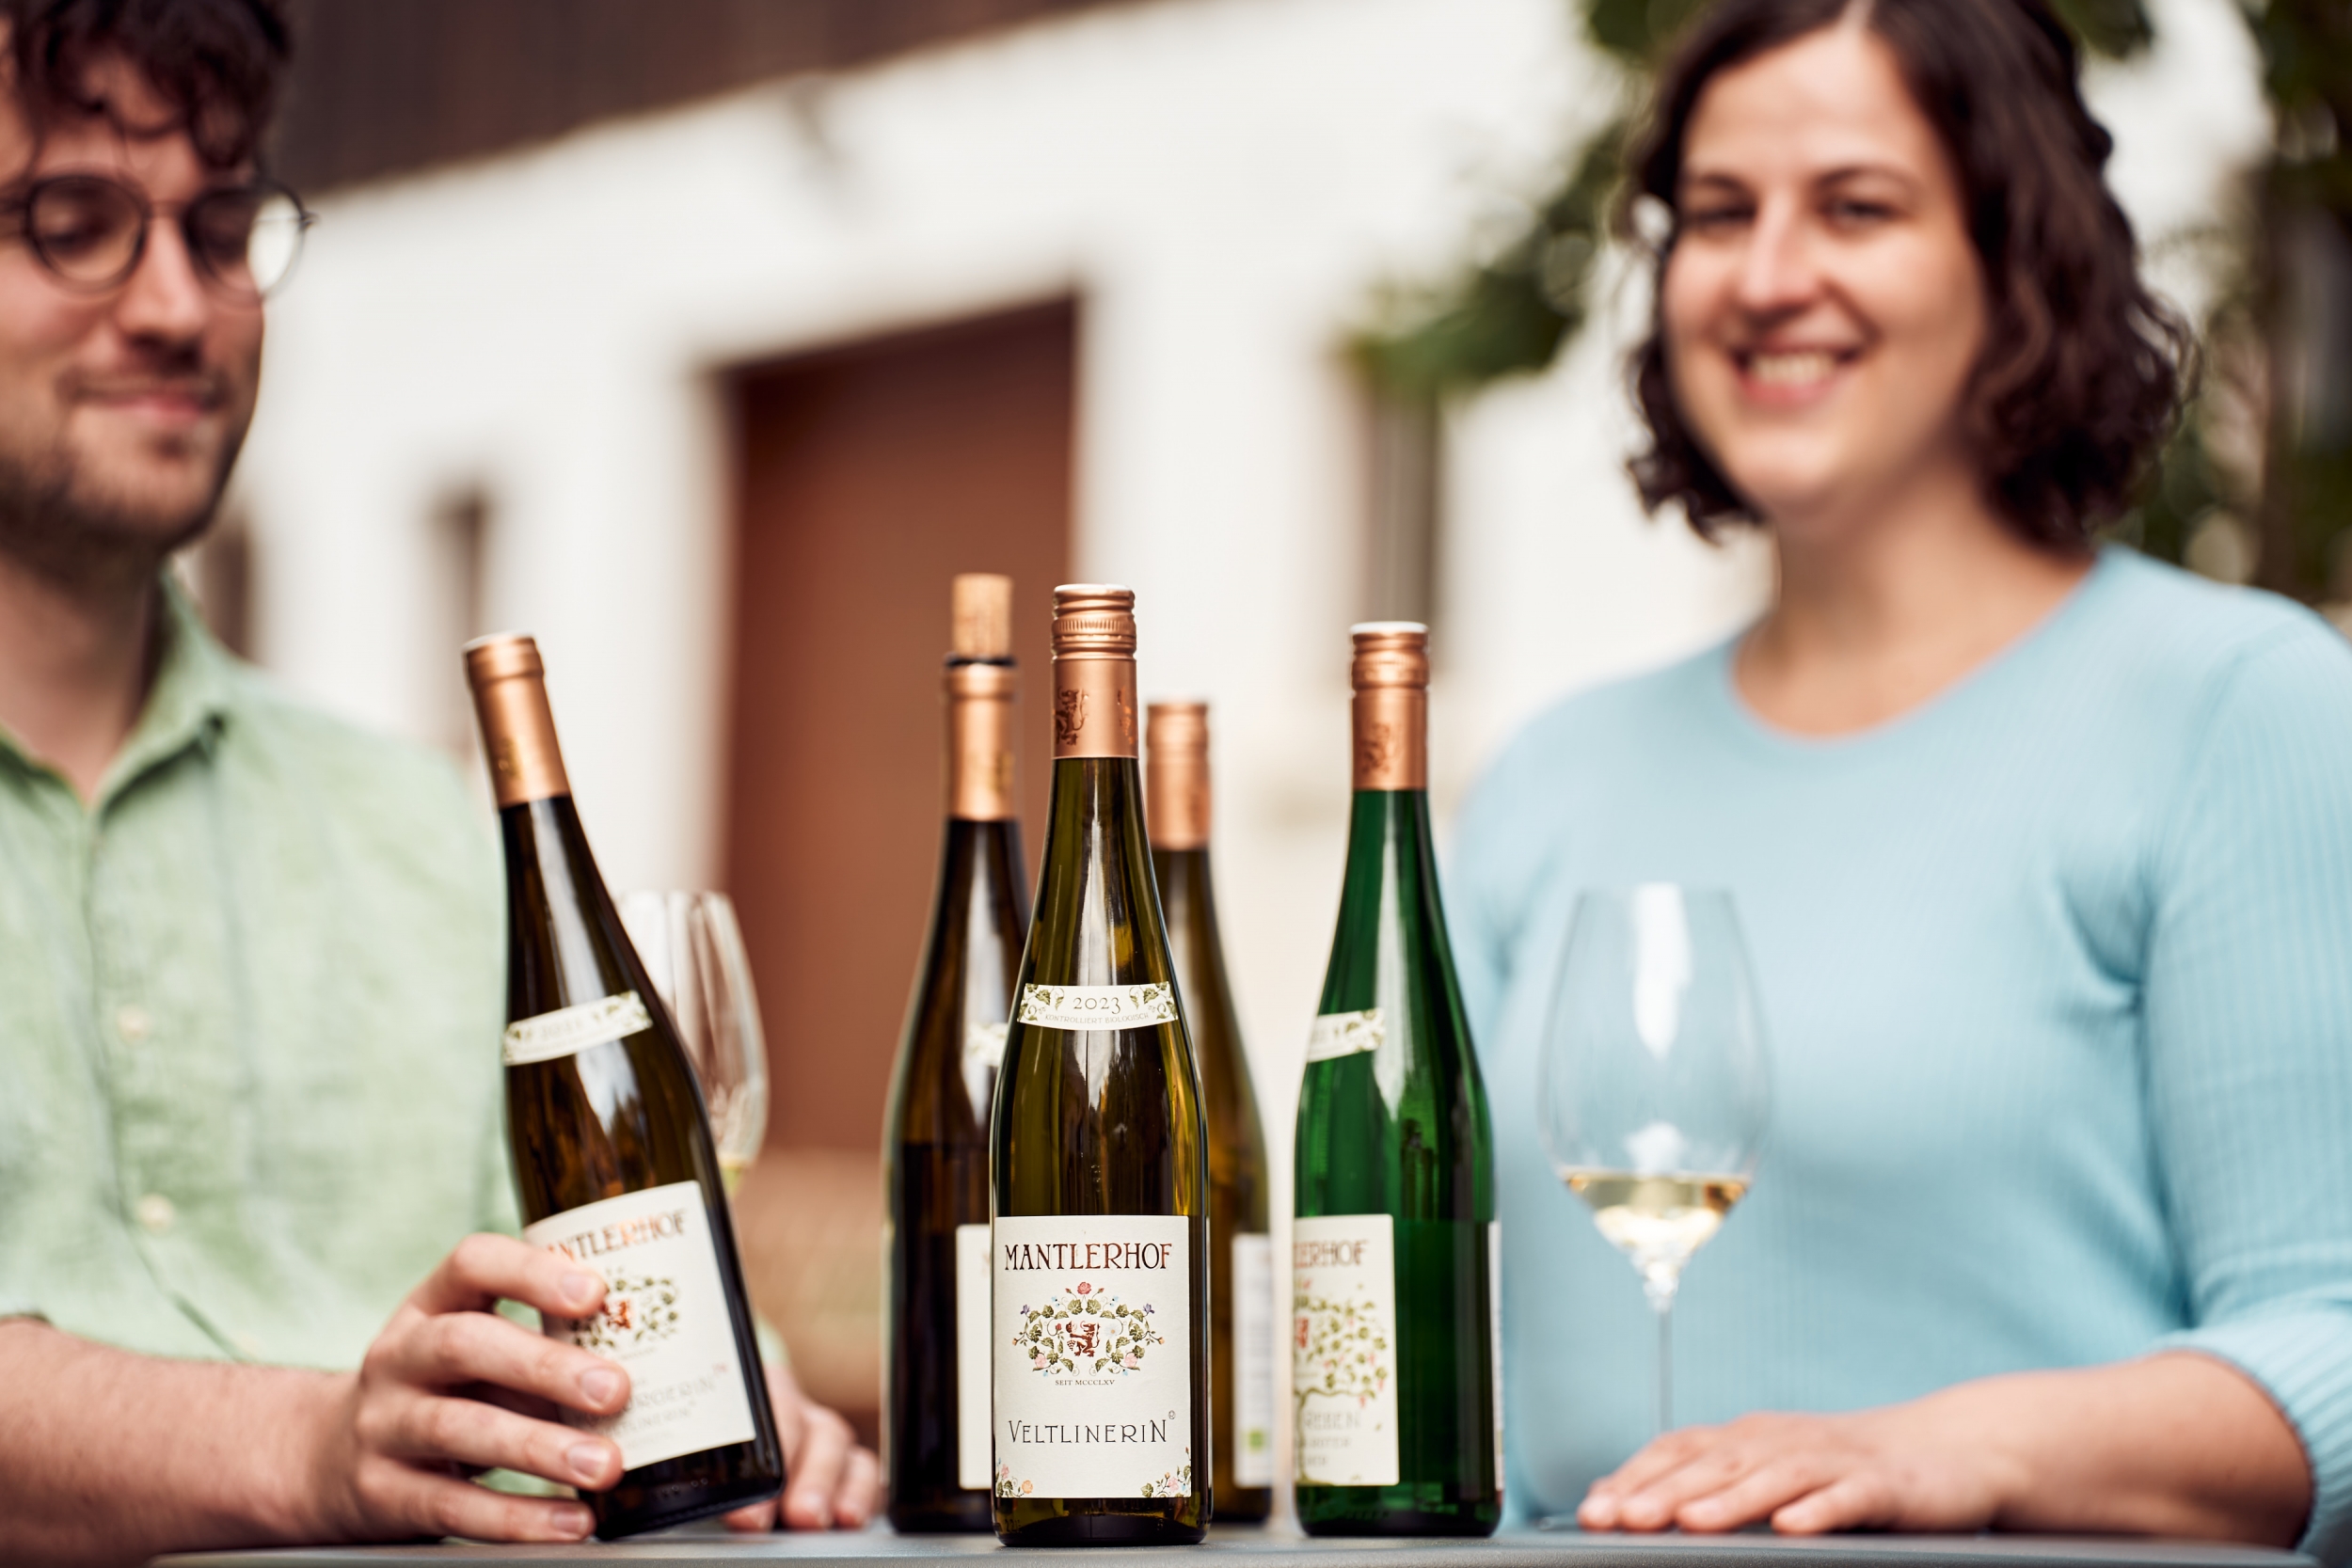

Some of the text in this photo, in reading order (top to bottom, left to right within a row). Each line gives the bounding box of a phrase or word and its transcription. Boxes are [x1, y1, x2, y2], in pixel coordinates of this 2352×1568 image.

[1073, 997, 1121, 1015] 2023
[1044, 1012, 1150, 1024] KONTROLLIERT BIOLOGISCH
[1004, 1243, 1173, 1271] MANTLERHOF
